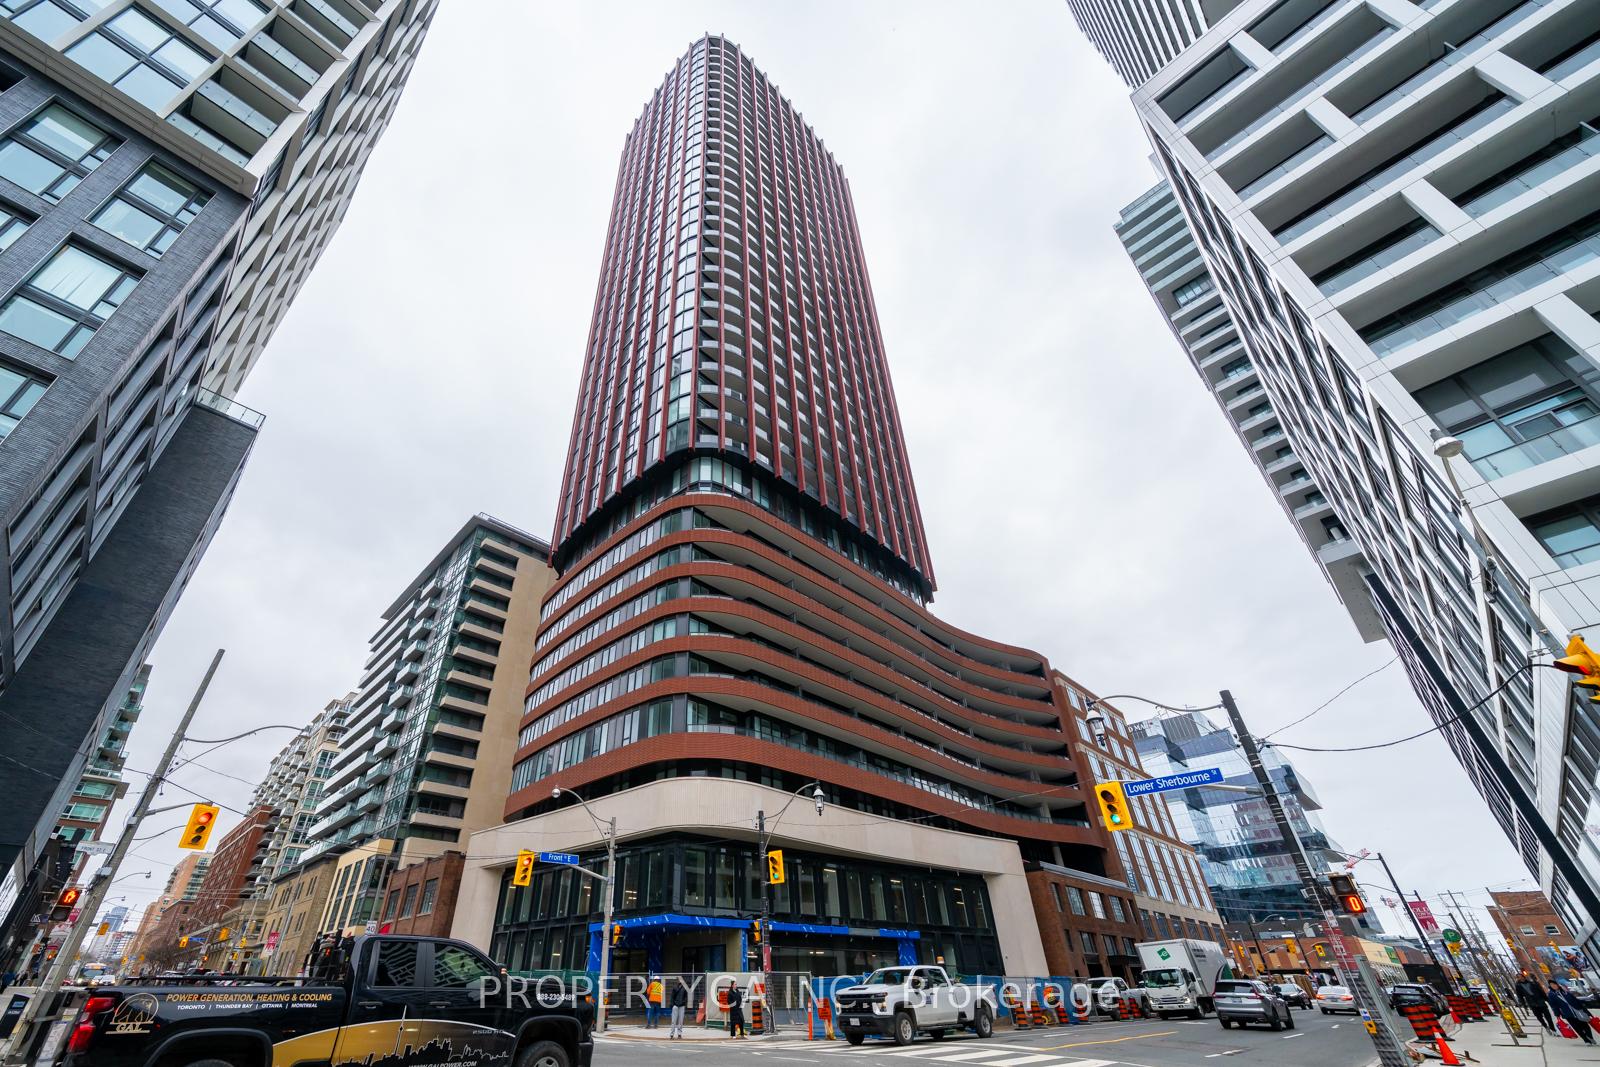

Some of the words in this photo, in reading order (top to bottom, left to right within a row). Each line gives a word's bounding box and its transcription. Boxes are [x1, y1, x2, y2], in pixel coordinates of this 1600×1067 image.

[1127, 782, 1154, 793] Lower
[1156, 772, 1210, 788] Sherbourne
[548, 853, 562, 861] Front
[166, 993, 199, 1002] POWER
[256, 993, 290, 1001] HEATING
[299, 993, 332, 1001] COOLING
